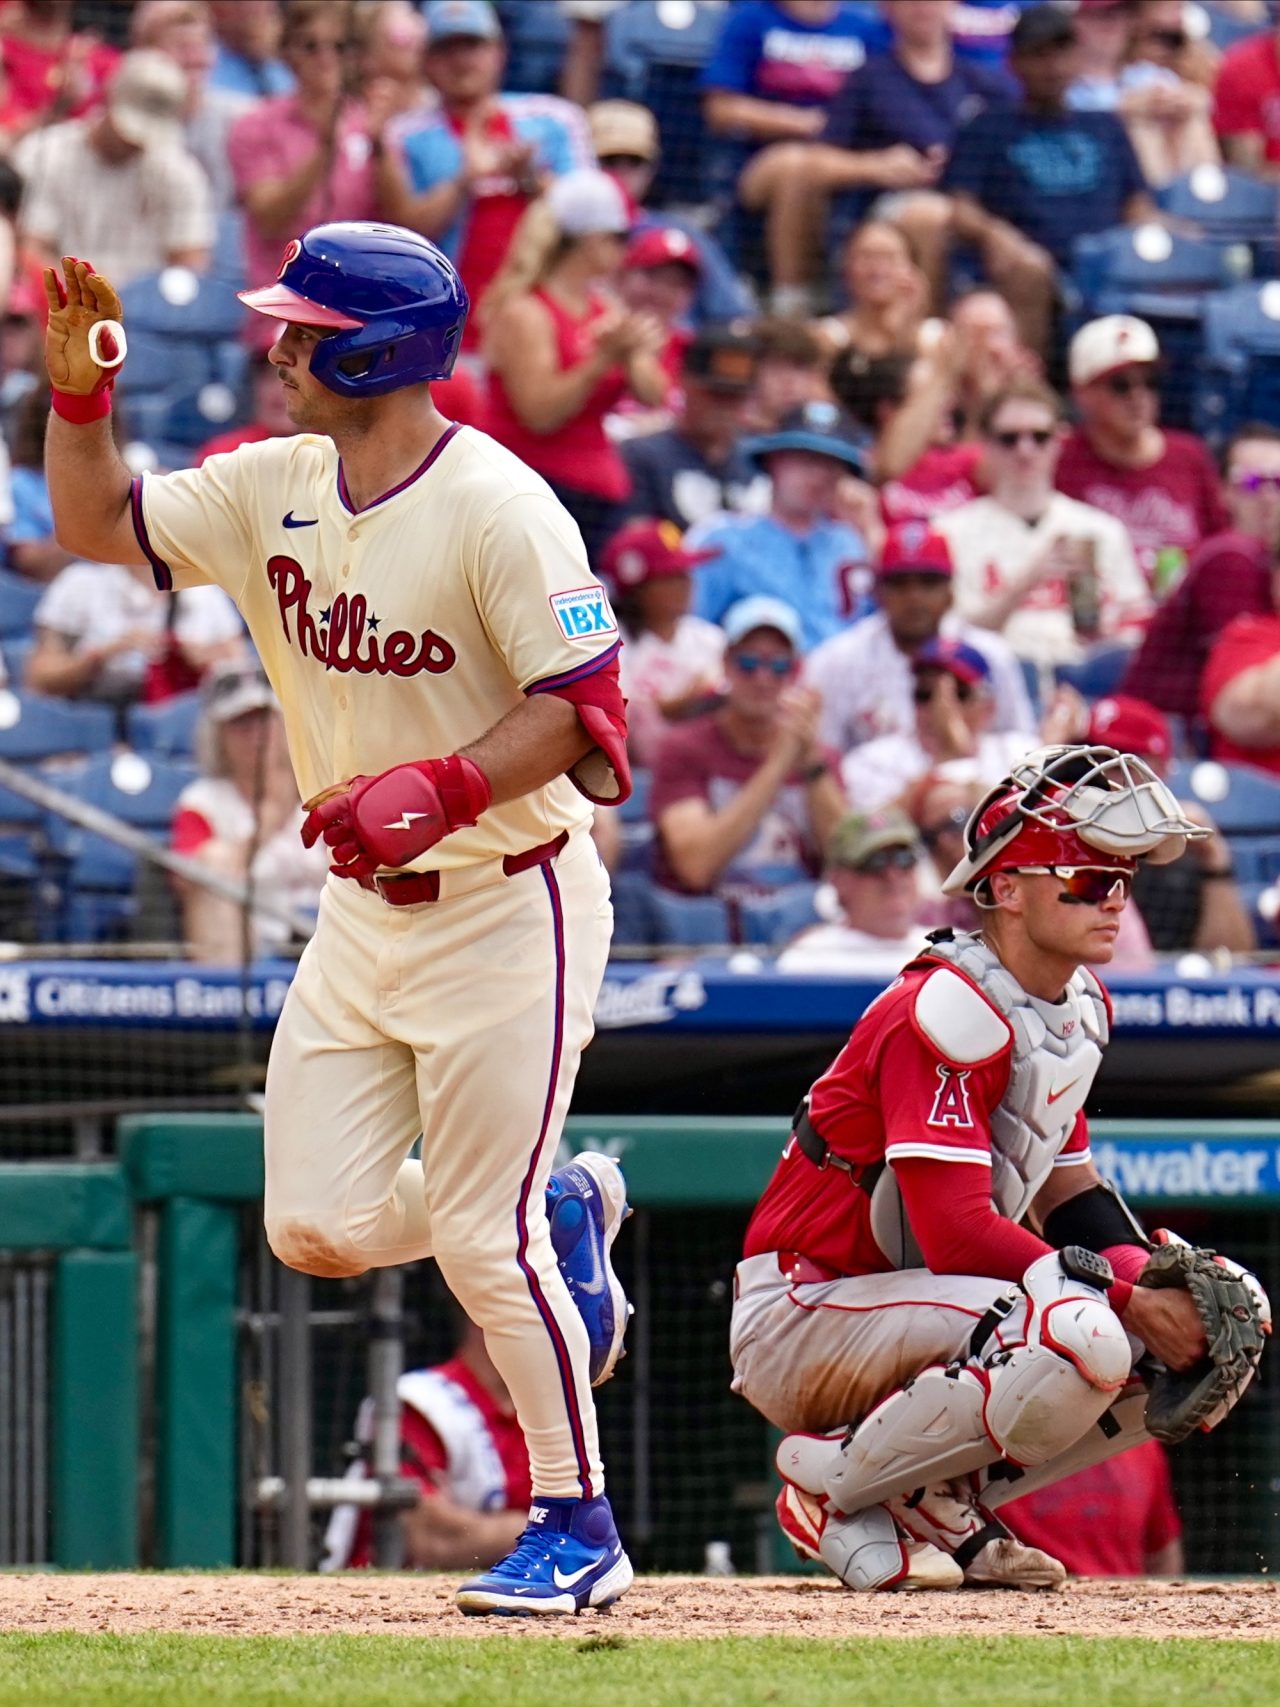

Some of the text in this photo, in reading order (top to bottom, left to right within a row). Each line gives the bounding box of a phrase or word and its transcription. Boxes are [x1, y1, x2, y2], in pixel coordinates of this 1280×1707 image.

[267, 555, 456, 677] Phillies
[558, 602, 611, 636] IBX
[34, 977, 173, 1017] Citizens
[1166, 985, 1251, 1027] Bank
[927, 1064, 974, 1128] A
[1094, 1142, 1267, 1195] twater
[528, 1505, 549, 1524] IKE
